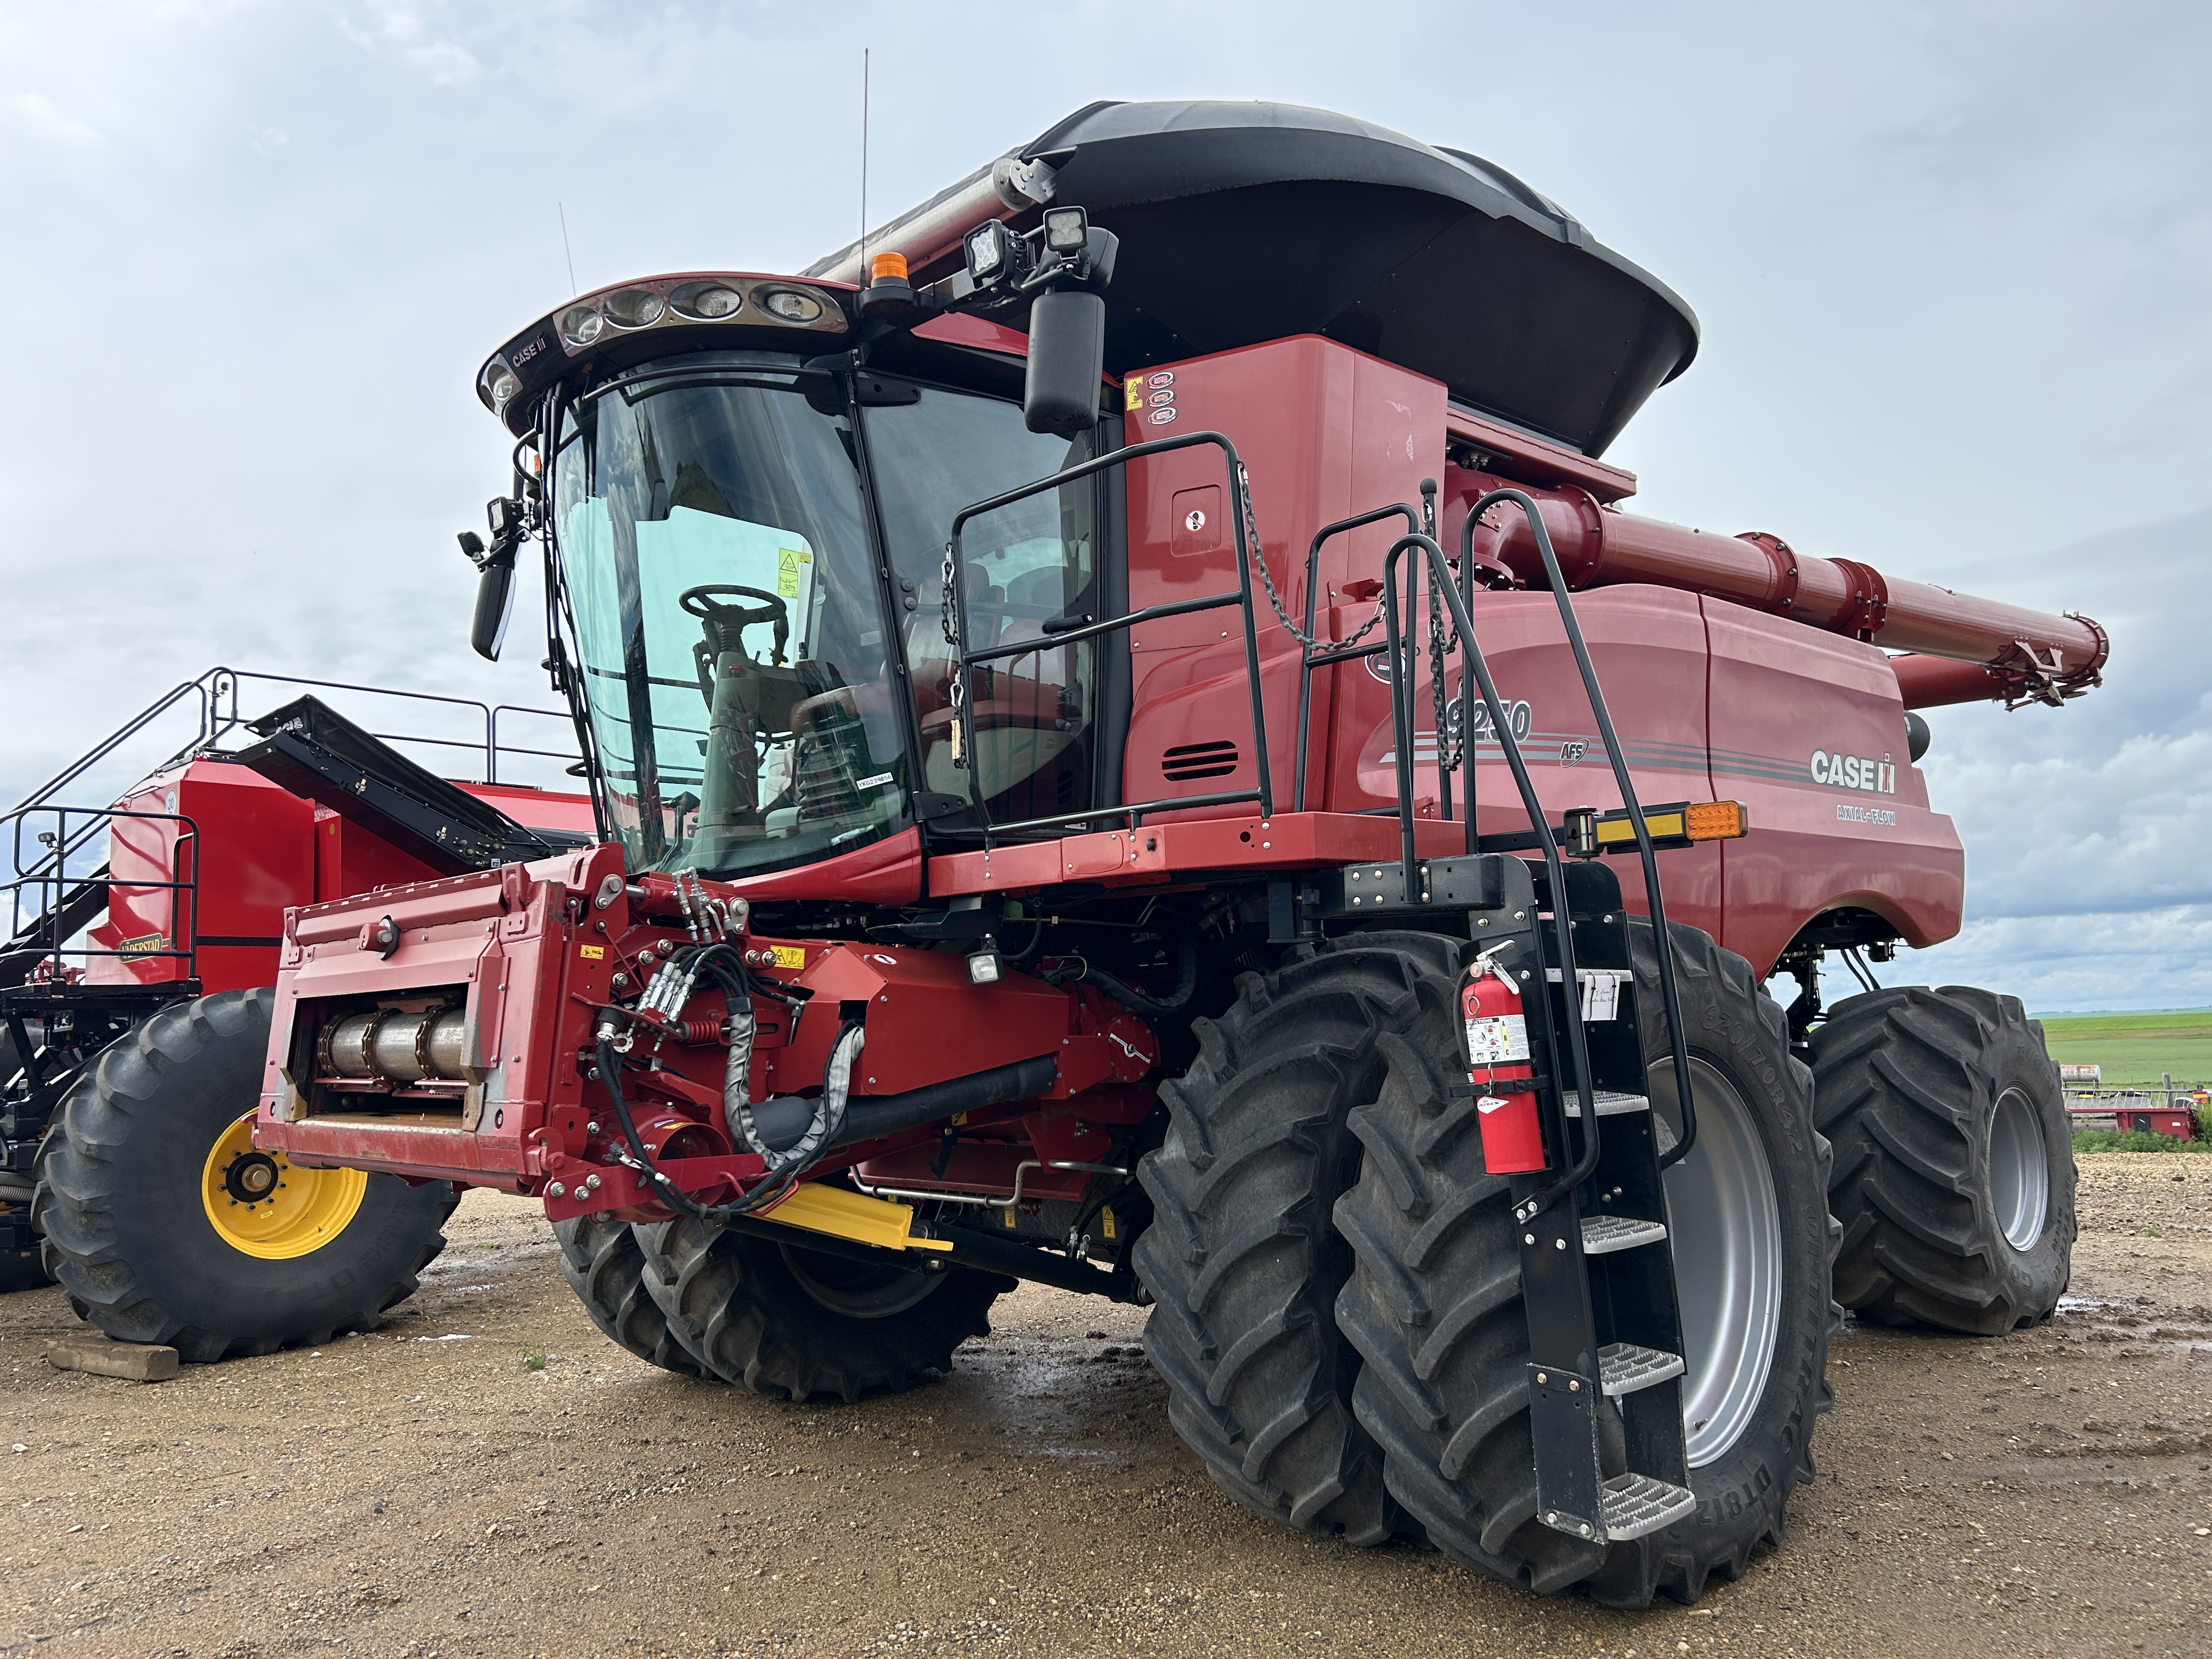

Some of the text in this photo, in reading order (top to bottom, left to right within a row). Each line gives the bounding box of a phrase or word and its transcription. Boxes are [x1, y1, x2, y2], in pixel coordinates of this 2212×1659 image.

[512, 344, 537, 368] CASE
[1559, 741, 1584, 761] AFS
[1810, 749, 1874, 791] CASE
[168, 797, 174, 810] 30
[1836, 804, 1896, 826] AXIAL-FLOW
[1778, 1204, 1821, 1456] OPTITRAC
[1695, 1461, 1772, 1527] DT812
